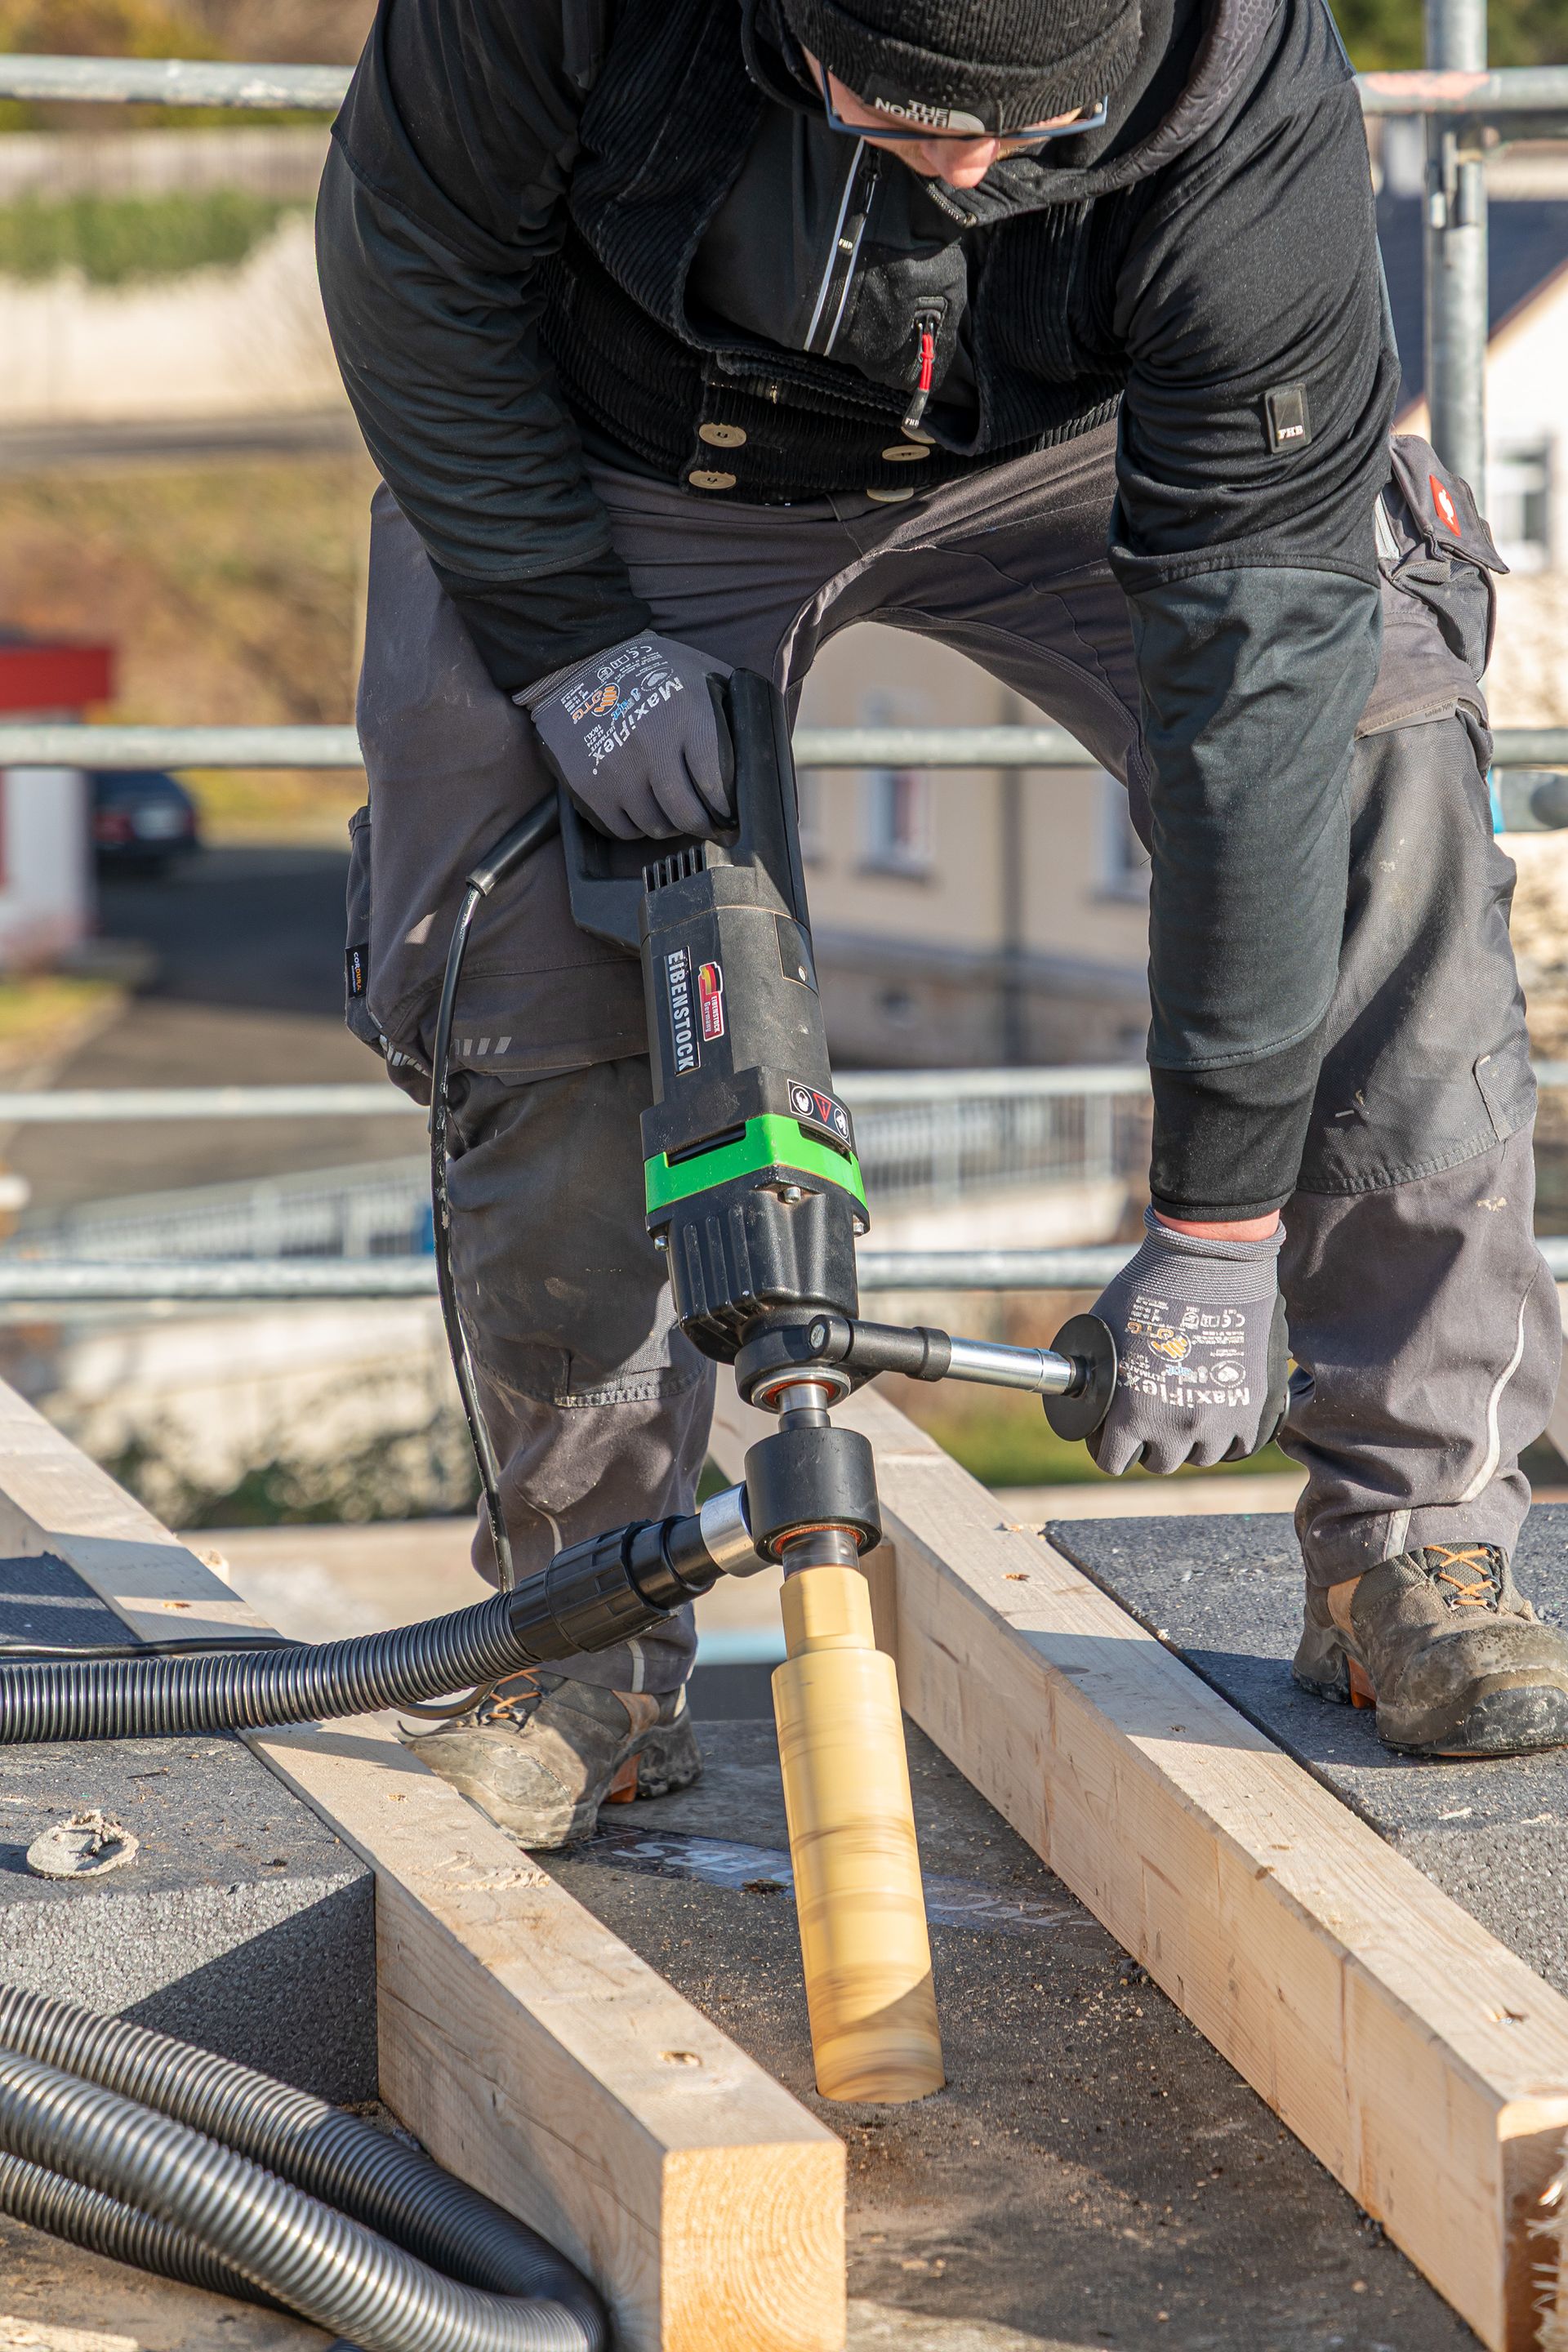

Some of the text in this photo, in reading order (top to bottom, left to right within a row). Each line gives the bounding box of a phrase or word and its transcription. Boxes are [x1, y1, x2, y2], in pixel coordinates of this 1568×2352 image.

[875, 96, 947, 128] NORTH
[908, 99, 950, 118] THE
[354, 951, 362, 991] CORDURA
[667, 950, 694, 1071] EIBENSTOCK
[703, 1002, 711, 1033] Germany
[710, 996, 719, 1033] EIBENSTOCK
